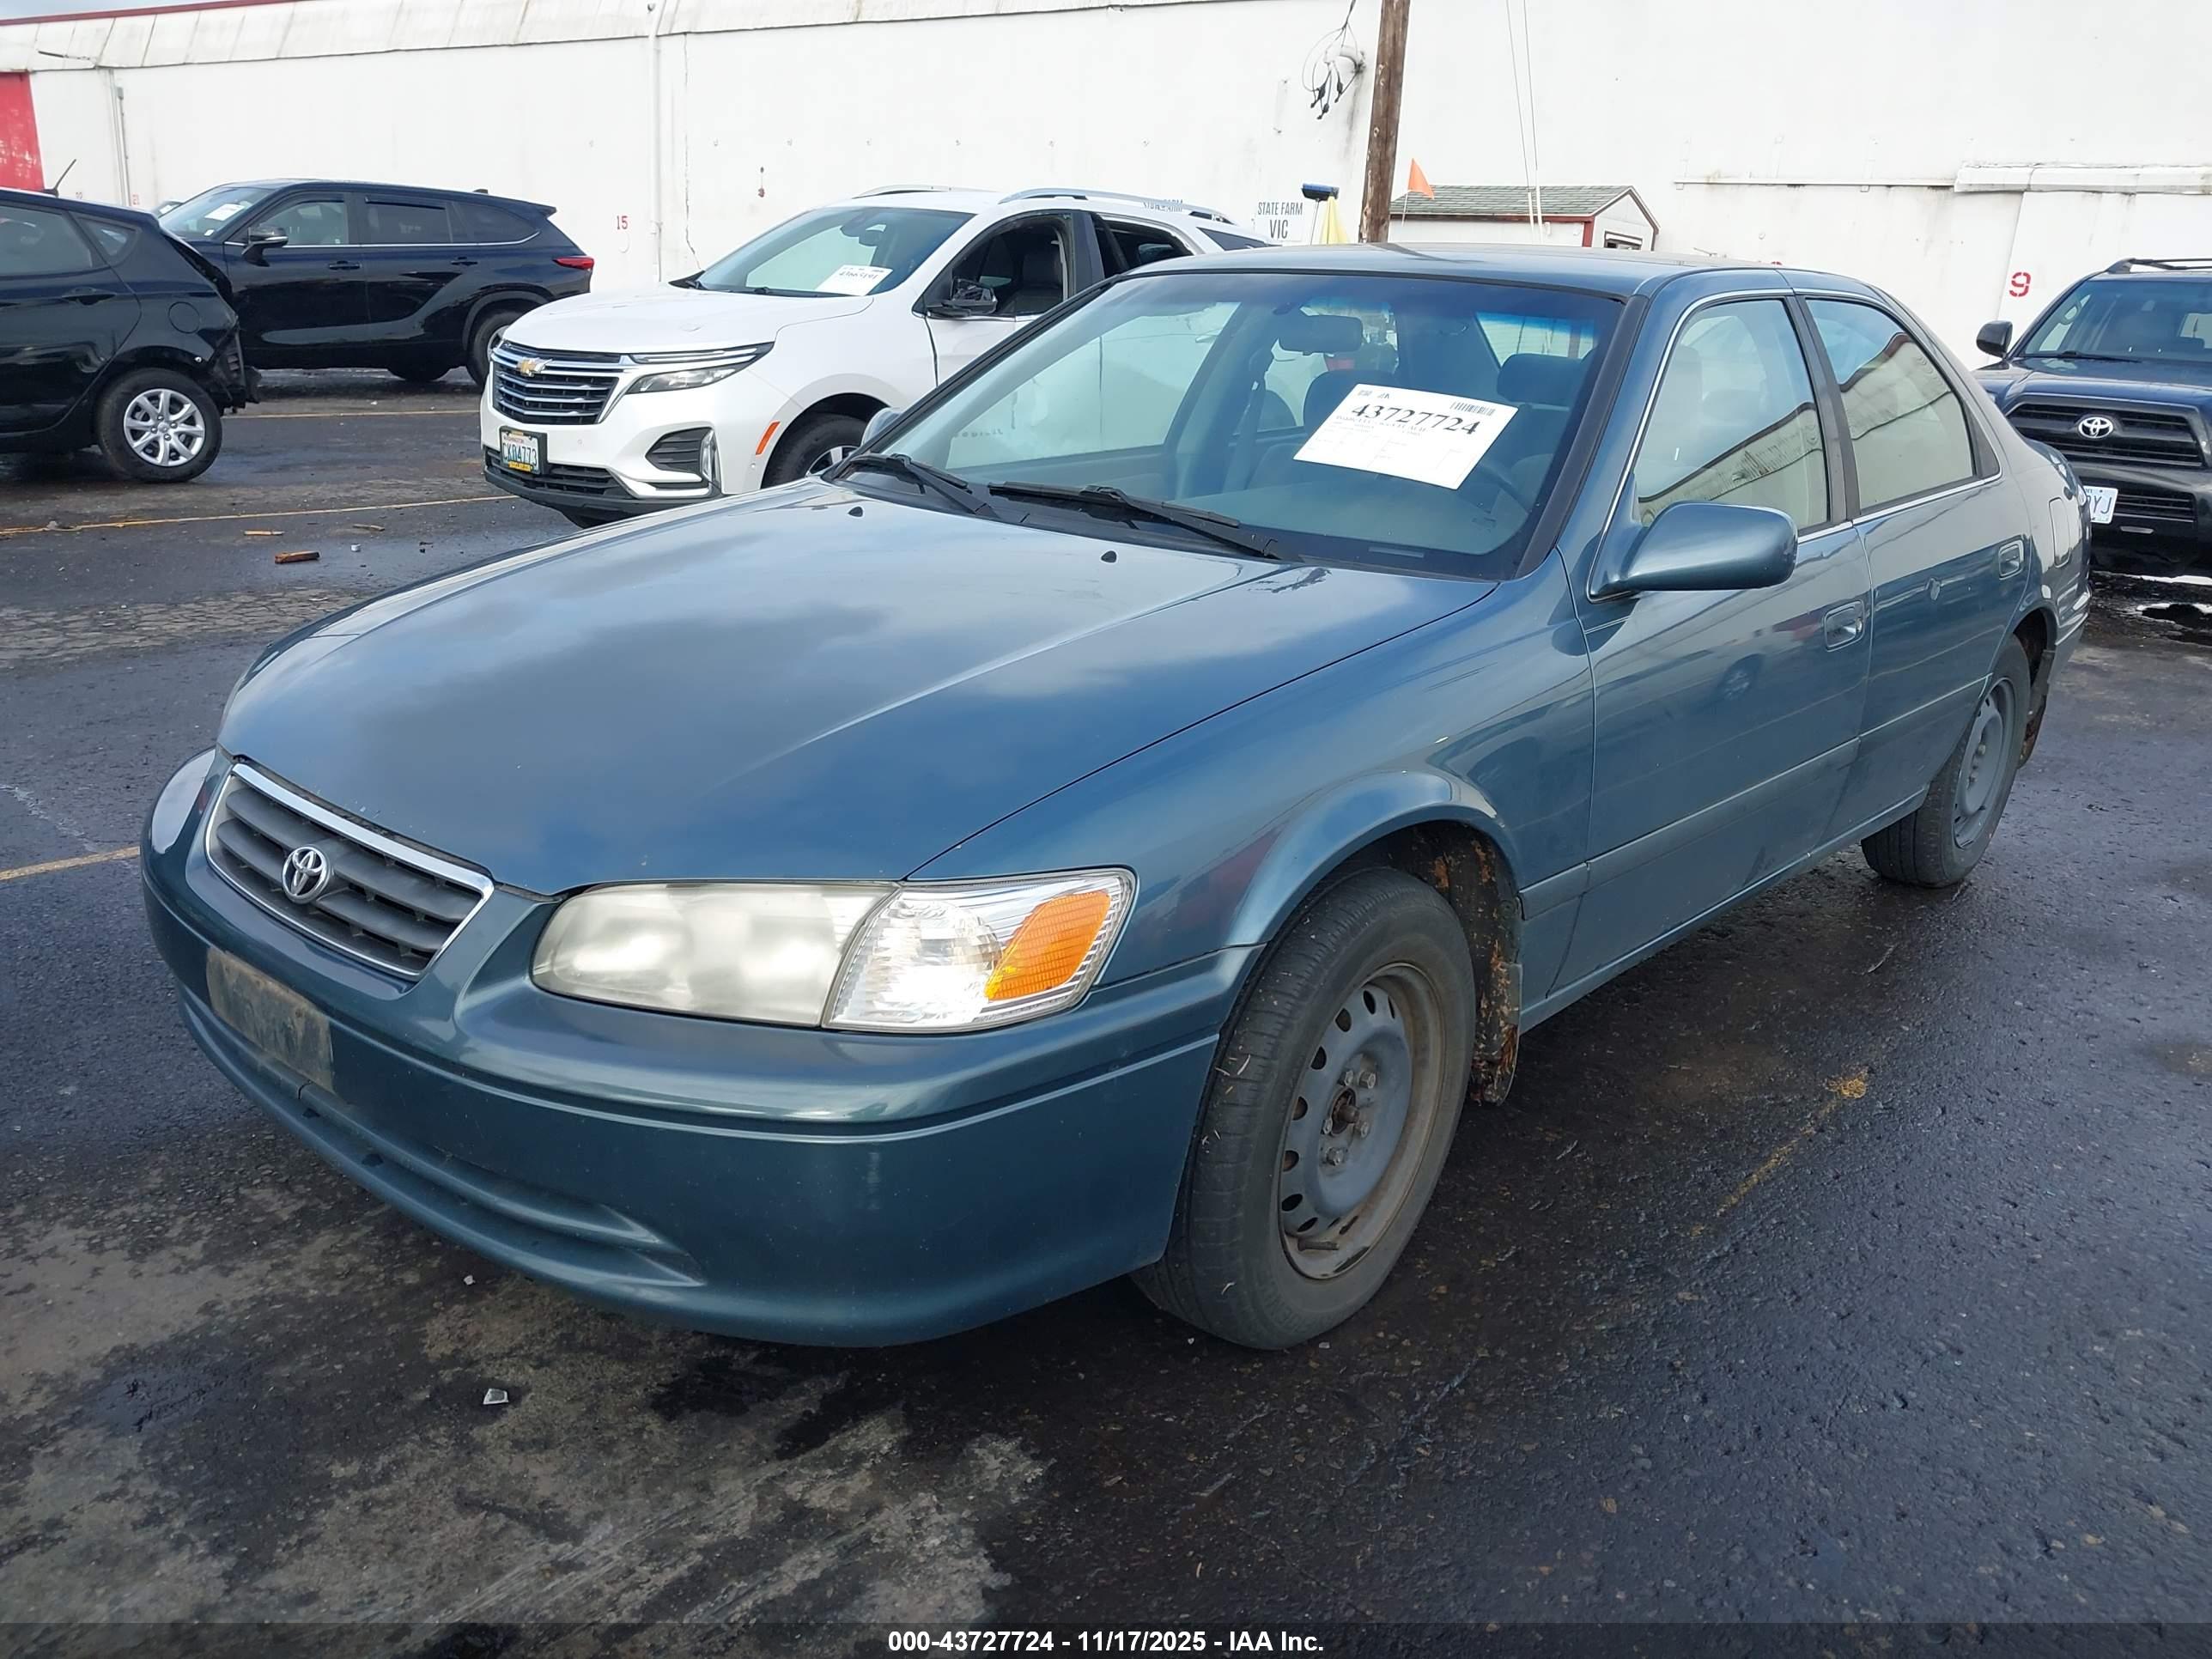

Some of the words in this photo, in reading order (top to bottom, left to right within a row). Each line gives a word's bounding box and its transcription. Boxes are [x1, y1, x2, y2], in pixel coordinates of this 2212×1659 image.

[1258, 202, 1279, 216] STATE
[1280, 202, 1304, 216] FARM
[617, 215, 629, 230] 15
[1269, 219, 1289, 239] VIC
[2009, 271, 2031, 297] 9
[1352, 404, 1482, 435] 43727724
